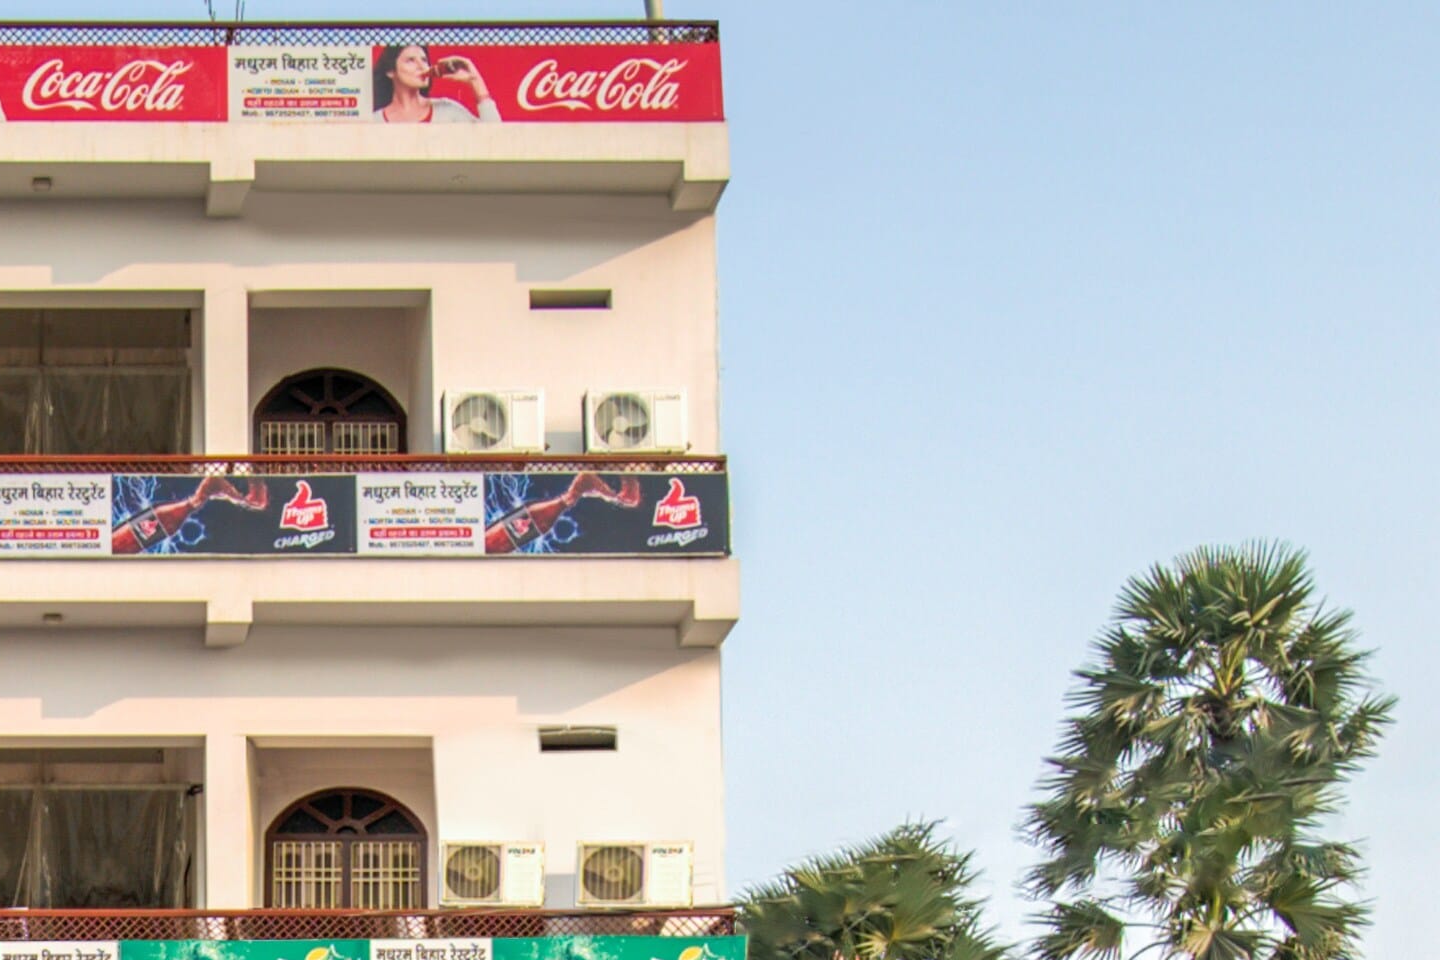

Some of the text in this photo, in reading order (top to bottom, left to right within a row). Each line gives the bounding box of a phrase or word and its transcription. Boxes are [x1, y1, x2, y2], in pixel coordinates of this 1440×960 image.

[22, 59, 194, 111] Coca-Cola
[517, 58, 688, 111] Coca-Cola
[273, 530, 335, 548] CHARGED
[647, 528, 708, 546] CHARGED
